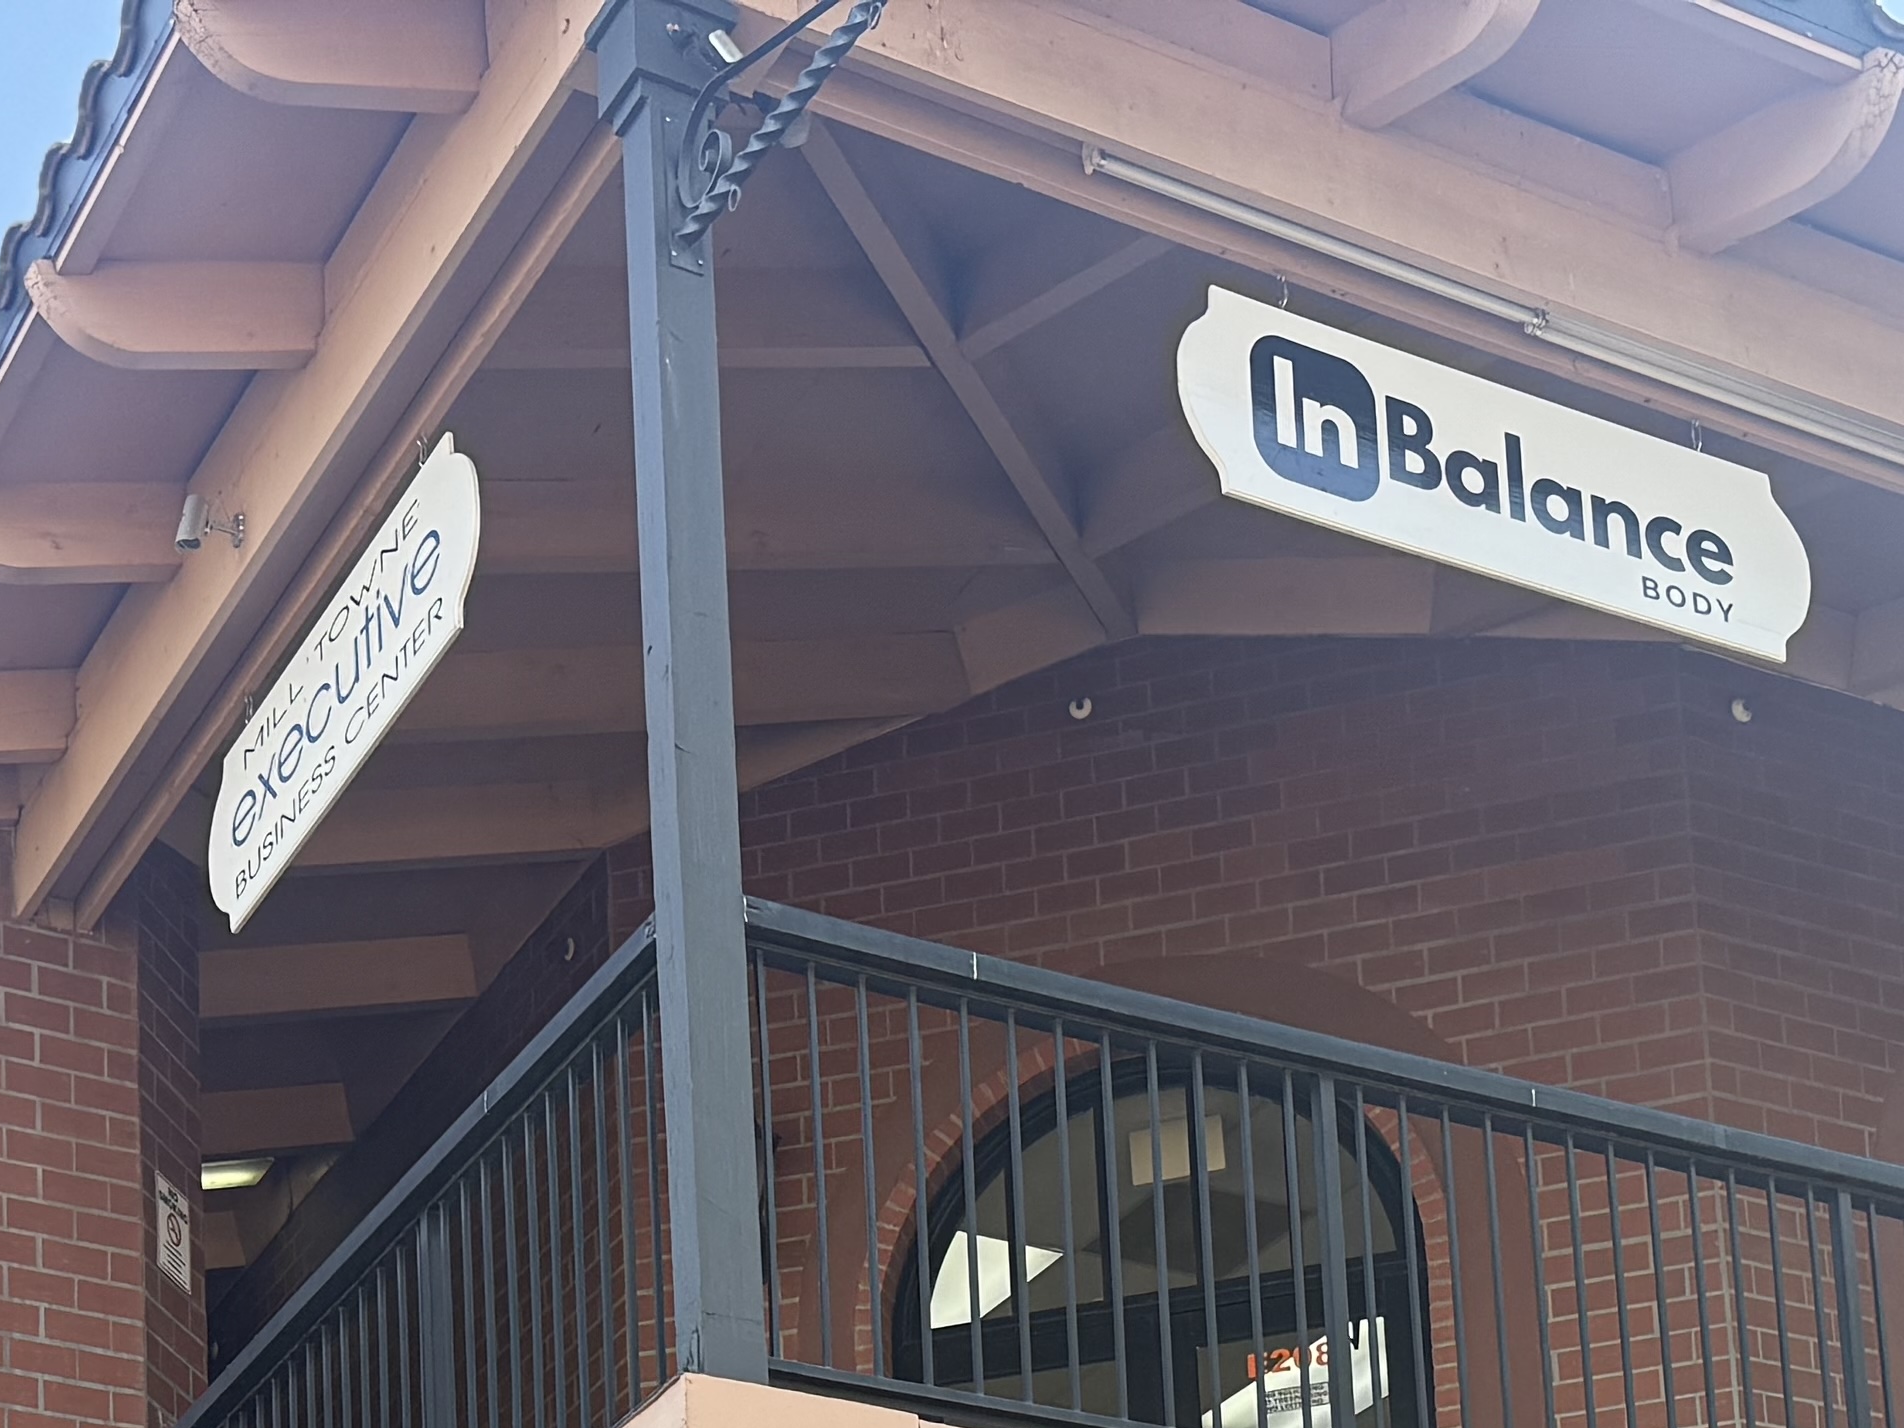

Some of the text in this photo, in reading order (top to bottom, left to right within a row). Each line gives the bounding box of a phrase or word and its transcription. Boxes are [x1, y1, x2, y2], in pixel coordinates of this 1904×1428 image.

[1385, 395, 1734, 585] Balance
[1642, 576, 1733, 623] BODY
[232, 530, 440, 847] executive
[236, 598, 442, 899] BUSINESS CENTER
[243, 499, 419, 770] MILL TOWNE
